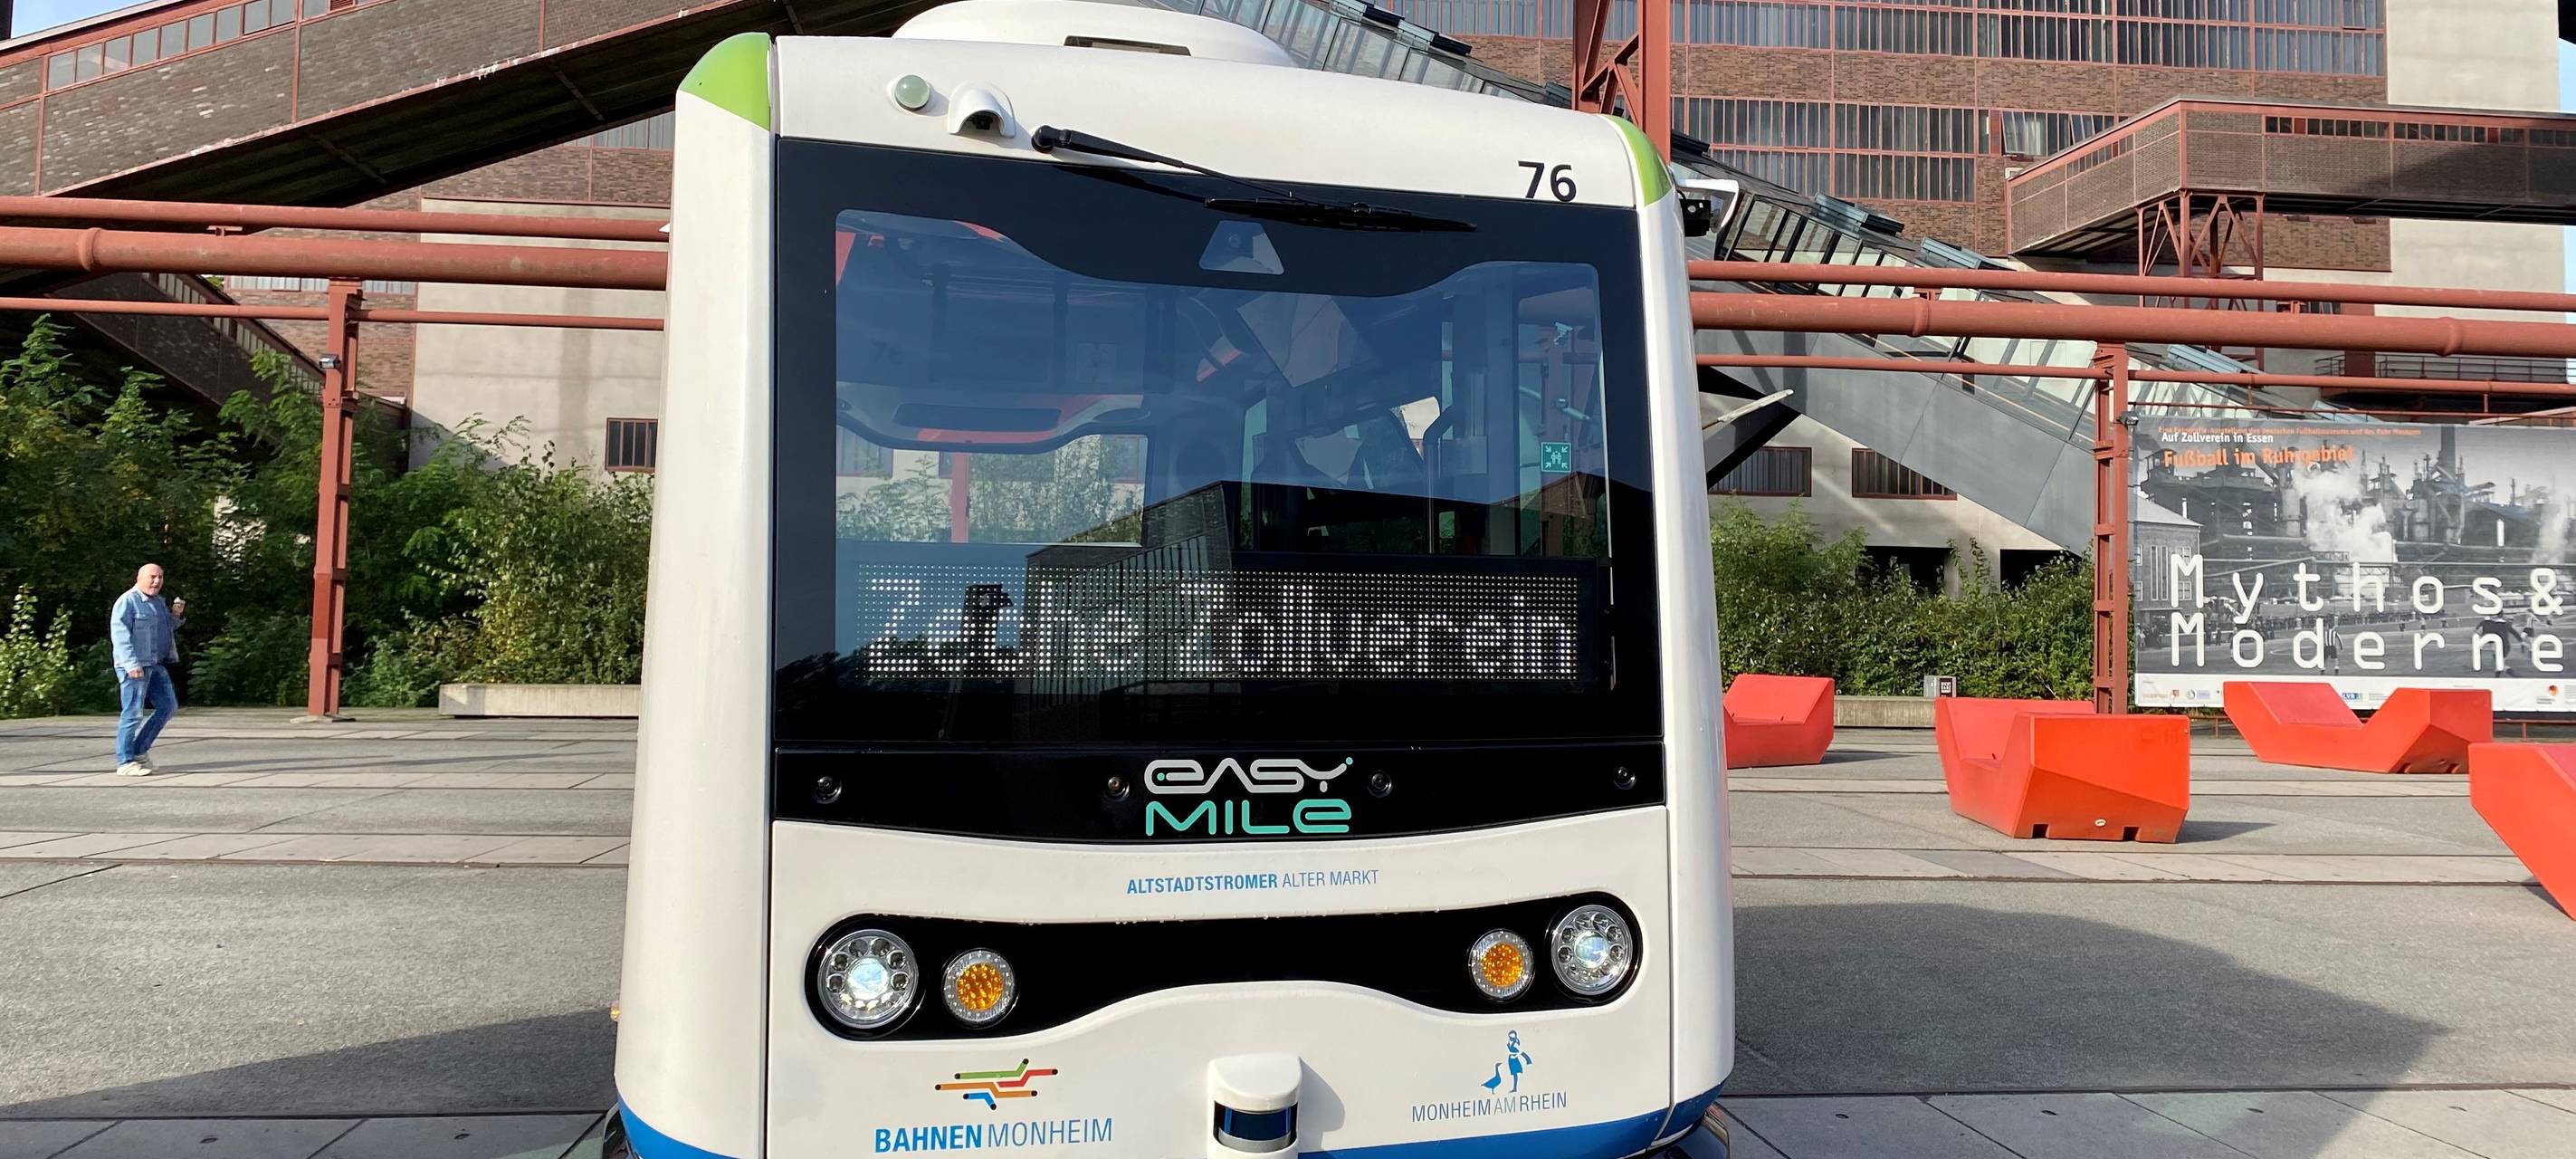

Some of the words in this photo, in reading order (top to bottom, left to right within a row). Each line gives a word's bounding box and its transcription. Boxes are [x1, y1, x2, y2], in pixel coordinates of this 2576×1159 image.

[1518, 160, 1577, 202] 76
[2161, 432, 2179, 442] Auf
[2181, 432, 2230, 443] Zollverein
[2233, 433, 2244, 443] in
[2247, 434, 2274, 443] Essen
[2163, 448, 2229, 467] Fußball
[2233, 447, 2256, 465] im
[2262, 445, 2354, 467] Ruhrgebiet
[869, 579, 1139, 672] Zeche
[1178, 583, 1572, 674] Zollverein
[2171, 612, 2564, 673] Moderne
[1127, 873, 1278, 894] ALTSTADTSTROMER
[1282, 872, 1325, 888] ALTER
[1330, 869, 1379, 887] MARKT
[874, 1125, 982, 1153] BAHNEN
[987, 1117, 1112, 1148] MONHEIM
